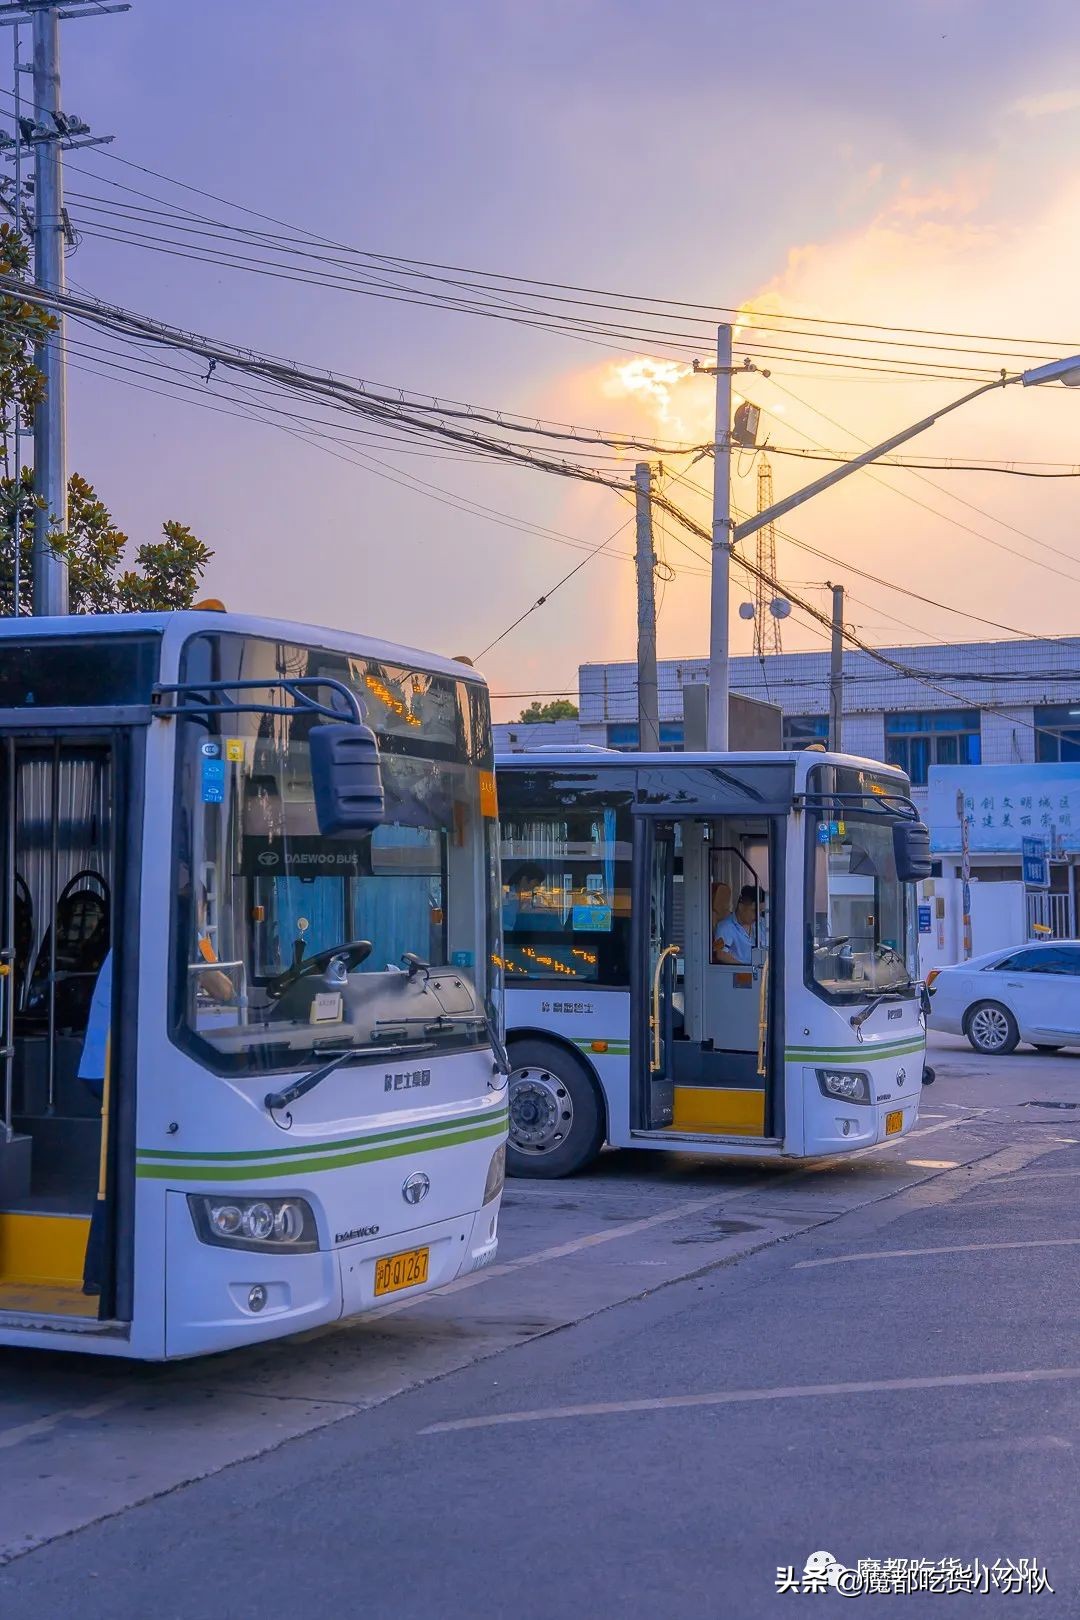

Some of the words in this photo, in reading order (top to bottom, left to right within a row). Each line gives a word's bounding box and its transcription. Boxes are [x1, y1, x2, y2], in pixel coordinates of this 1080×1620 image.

[285, 854, 336, 864] DAEWOO
[336, 854, 359, 864] BUS
[335, 1225, 380, 1243] DAEWOO
